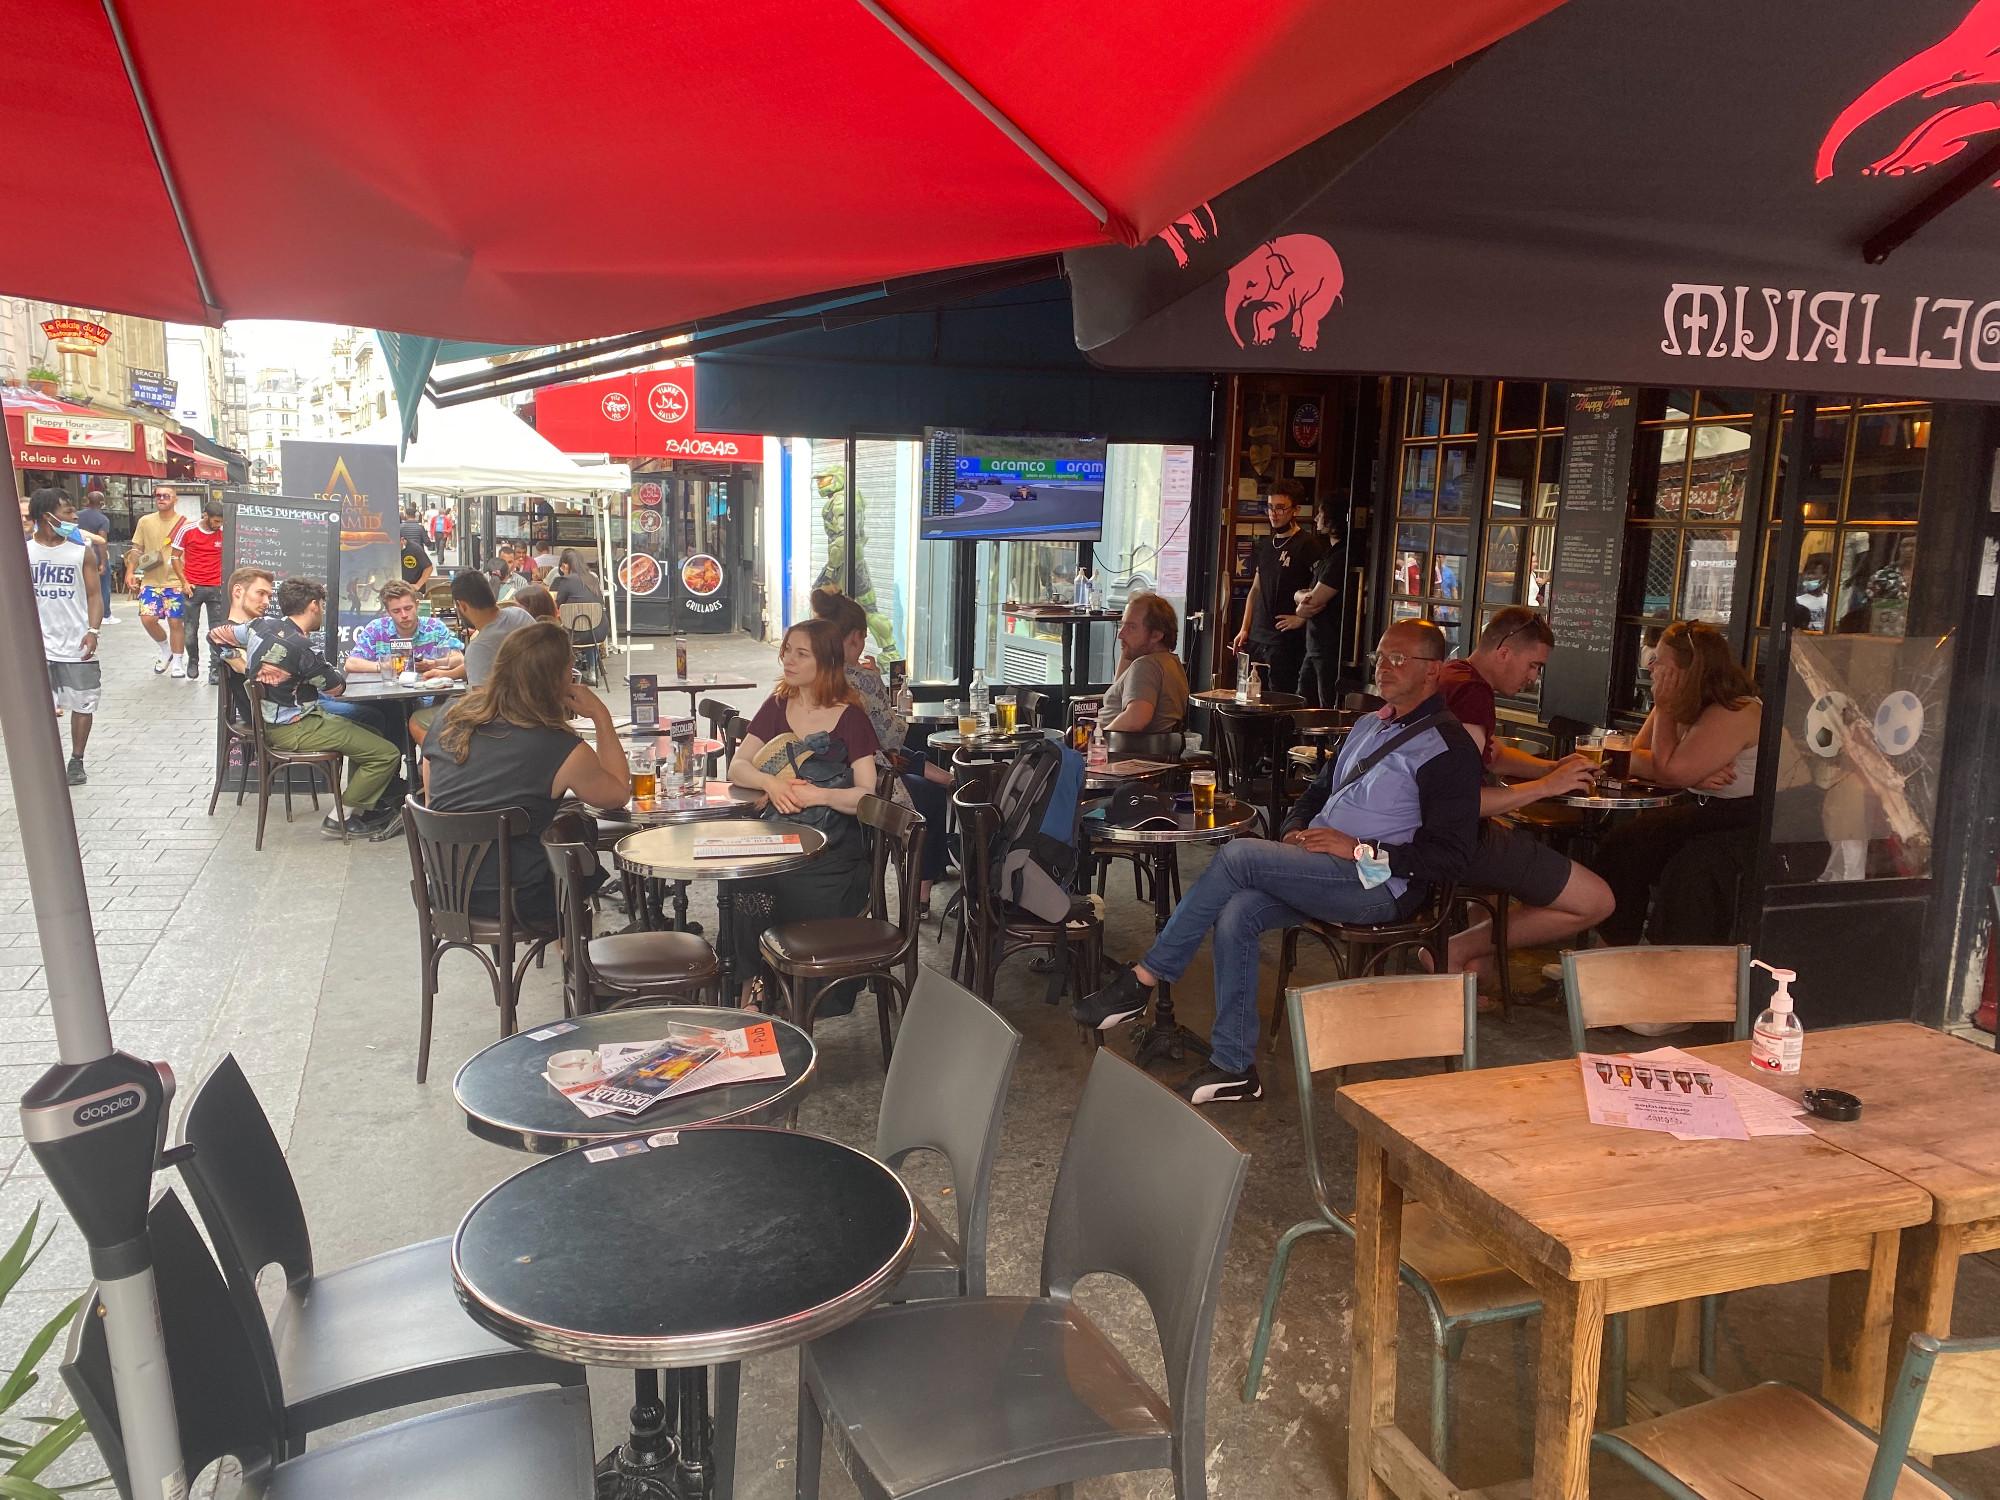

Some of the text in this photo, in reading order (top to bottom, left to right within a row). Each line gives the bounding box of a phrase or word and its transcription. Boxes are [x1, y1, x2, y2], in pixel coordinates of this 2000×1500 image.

[42, 319, 109, 340] Le Relais du Vin
[36, 418, 63, 428] Happy
[65, 419, 84, 429] Hour
[665, 438, 739, 456] BAOBAB
[20, 450, 101, 466] Relais du Vin
[991, 460, 1046, 472] aramco
[288, 509, 329, 521] MOMENT
[685, 599, 723, 613] GRILLADES
[80, 1095, 134, 1121] doppler
